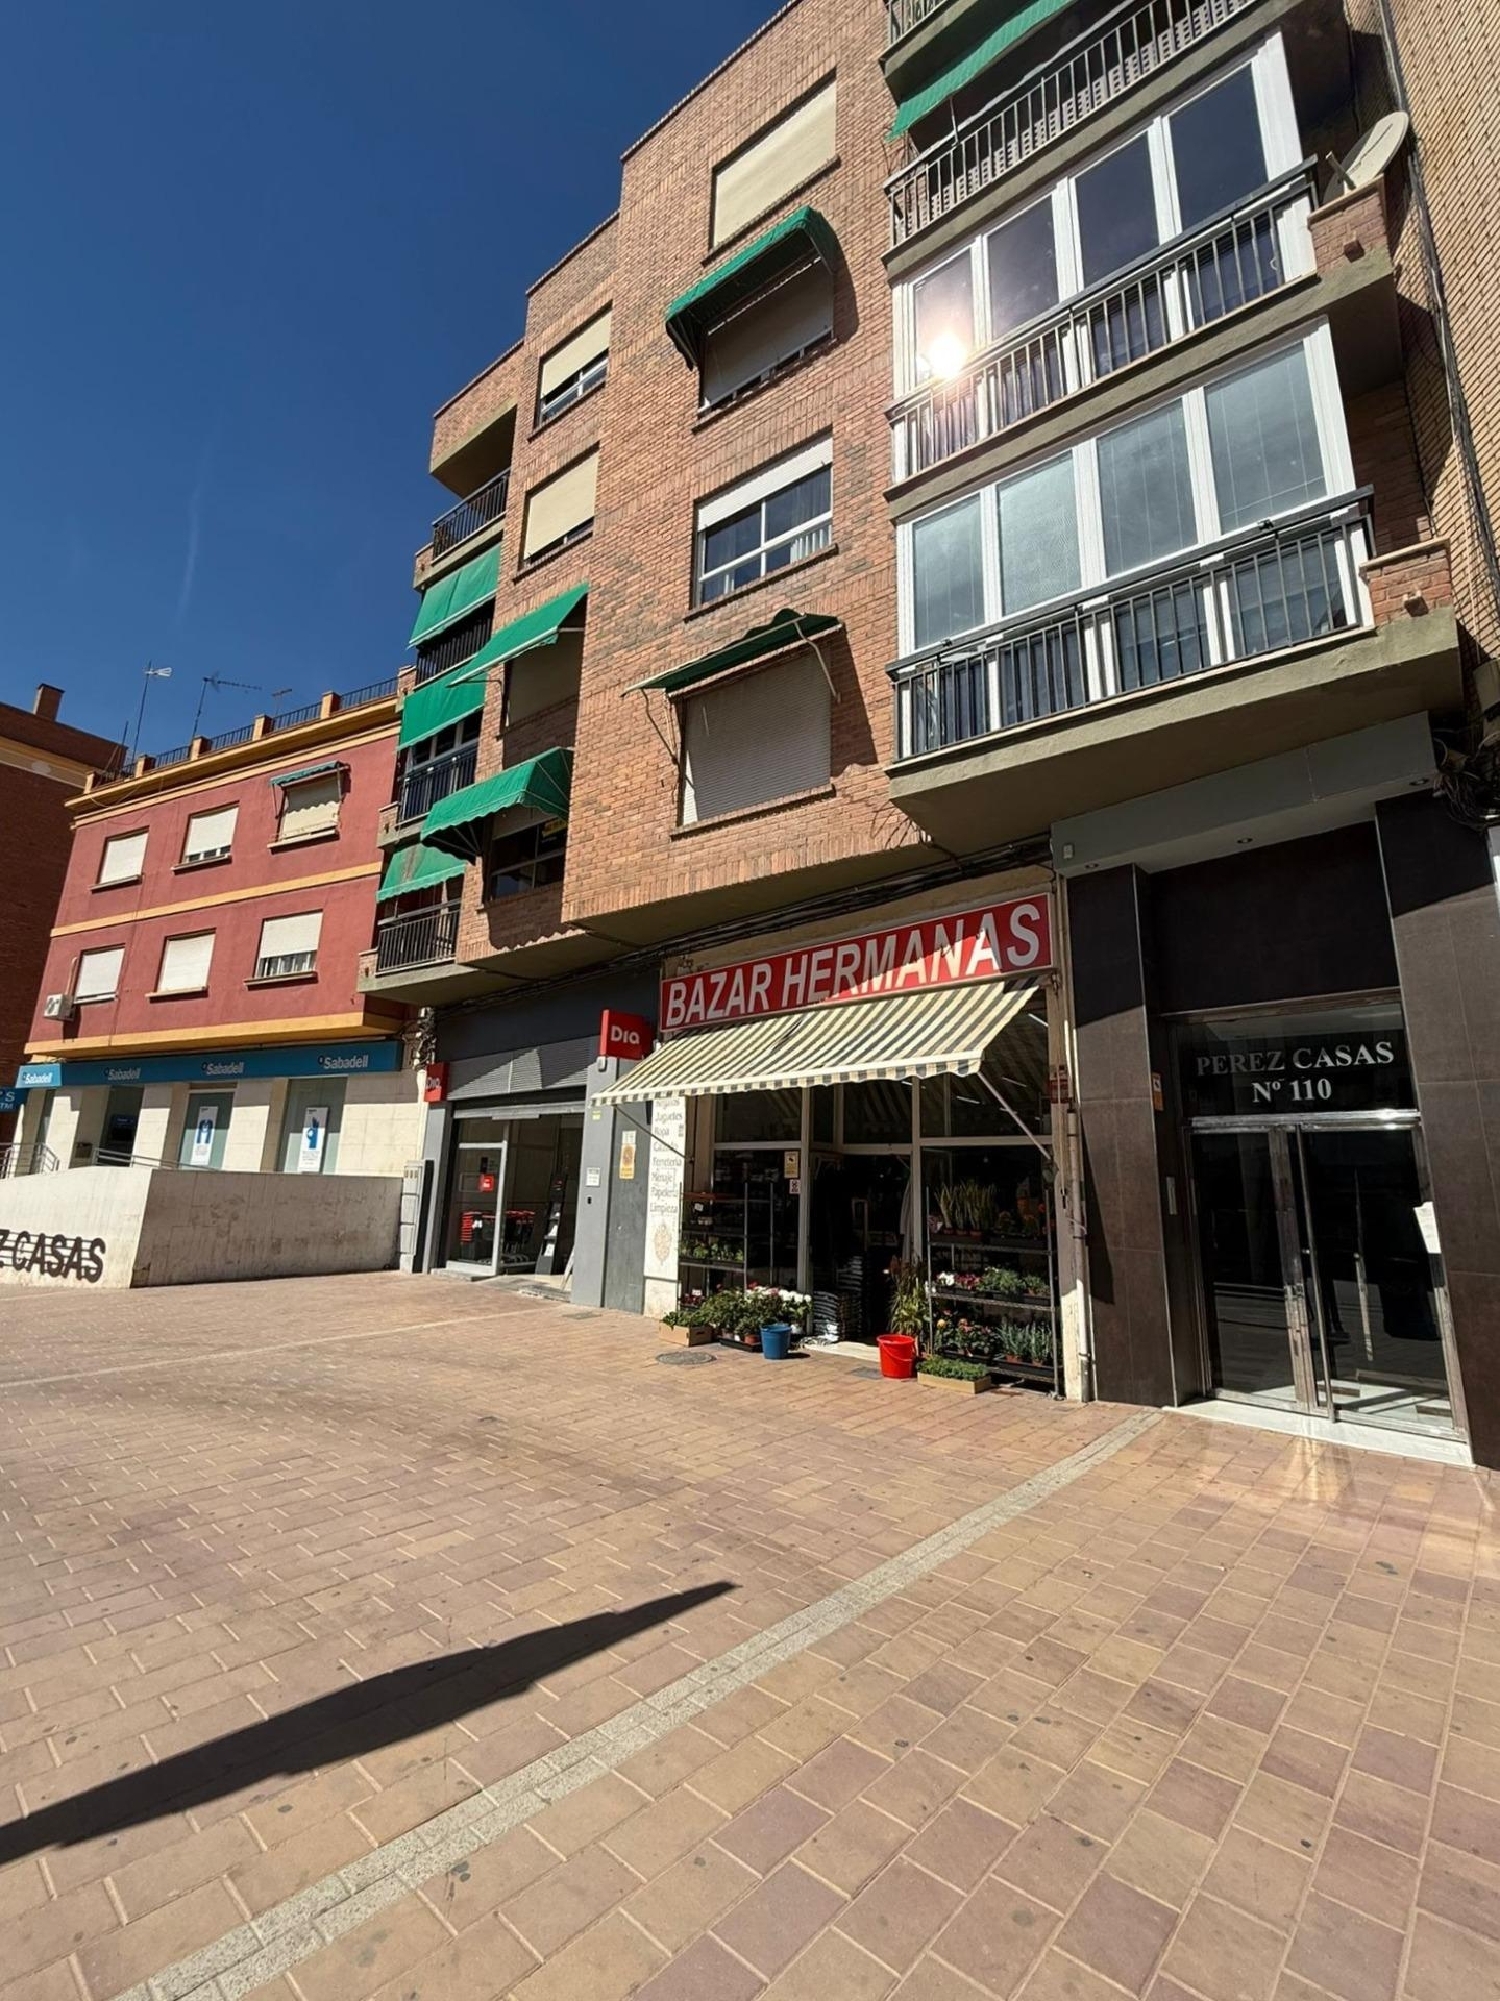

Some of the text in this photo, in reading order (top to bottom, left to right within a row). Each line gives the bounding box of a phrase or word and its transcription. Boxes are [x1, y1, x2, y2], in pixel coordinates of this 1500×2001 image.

[665, 903, 1041, 1028] BAZAR HERMANAS
[324, 1055, 369, 1069] Sabadell
[1197, 1041, 1395, 1077] PEREZ CASAS
[107, 1067, 141, 1080] Sabadell
[206, 1062, 245, 1075] Sabadell
[25, 1072, 53, 1084] Sabadell
[1290, 1078, 1333, 1101] 110
[654, 1126, 670, 1138] Ropa
[13, 1230, 106, 1283] CASAS
